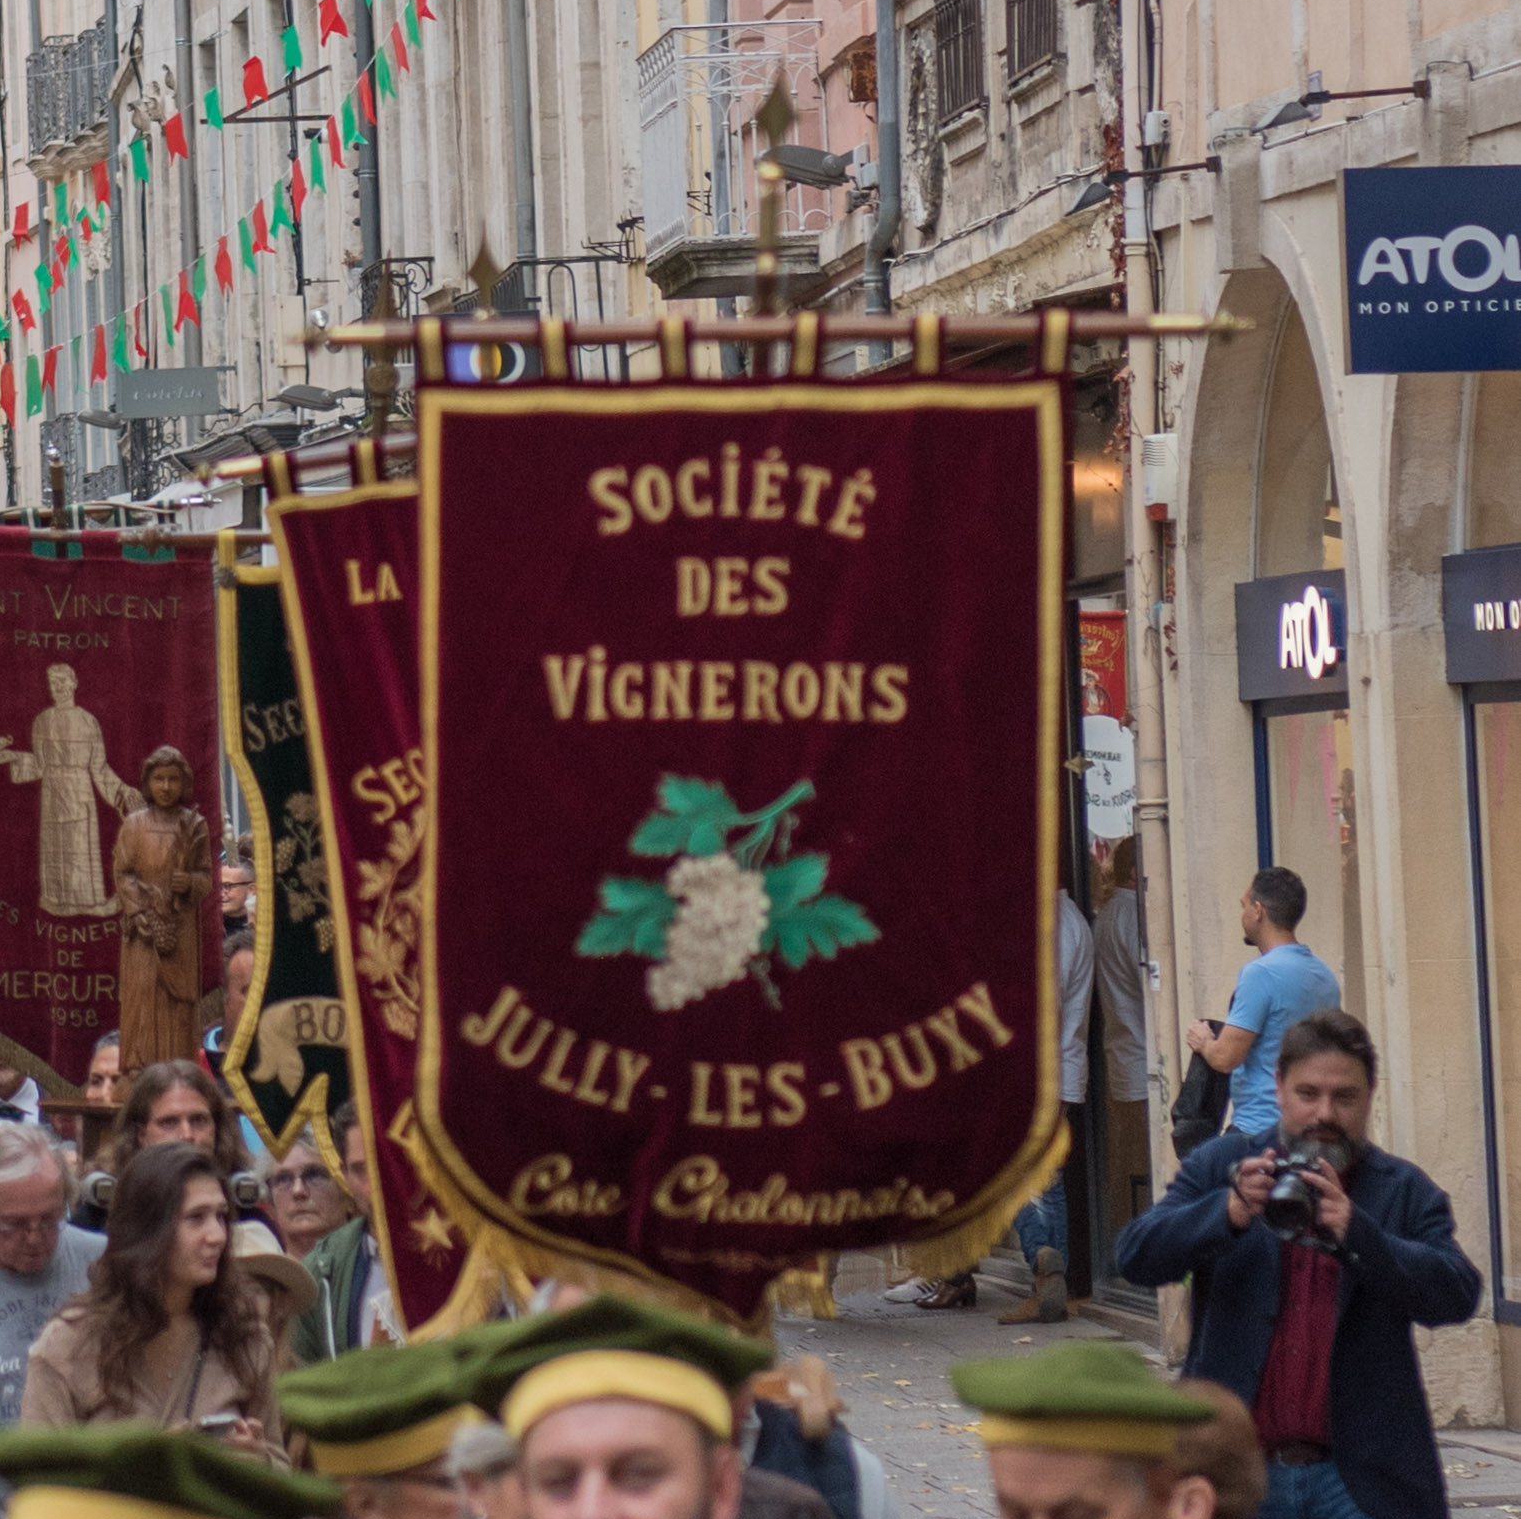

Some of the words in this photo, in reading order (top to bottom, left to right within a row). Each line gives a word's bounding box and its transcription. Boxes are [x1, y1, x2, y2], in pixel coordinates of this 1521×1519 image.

[1358, 301, 1410, 315] MON
[344, 558, 402, 606] LA
[675, 555, 791, 617] DES
[44, 583, 183, 621] VINCENT
[1474, 601, 1506, 632] MON
[1509, 599, 1521, 631] O
[14, 631, 110, 650] PATRON
[1279, 584, 1337, 680] ATOL
[57, 950, 84, 968] DE
[50, 1007, 100, 1029] 1958
